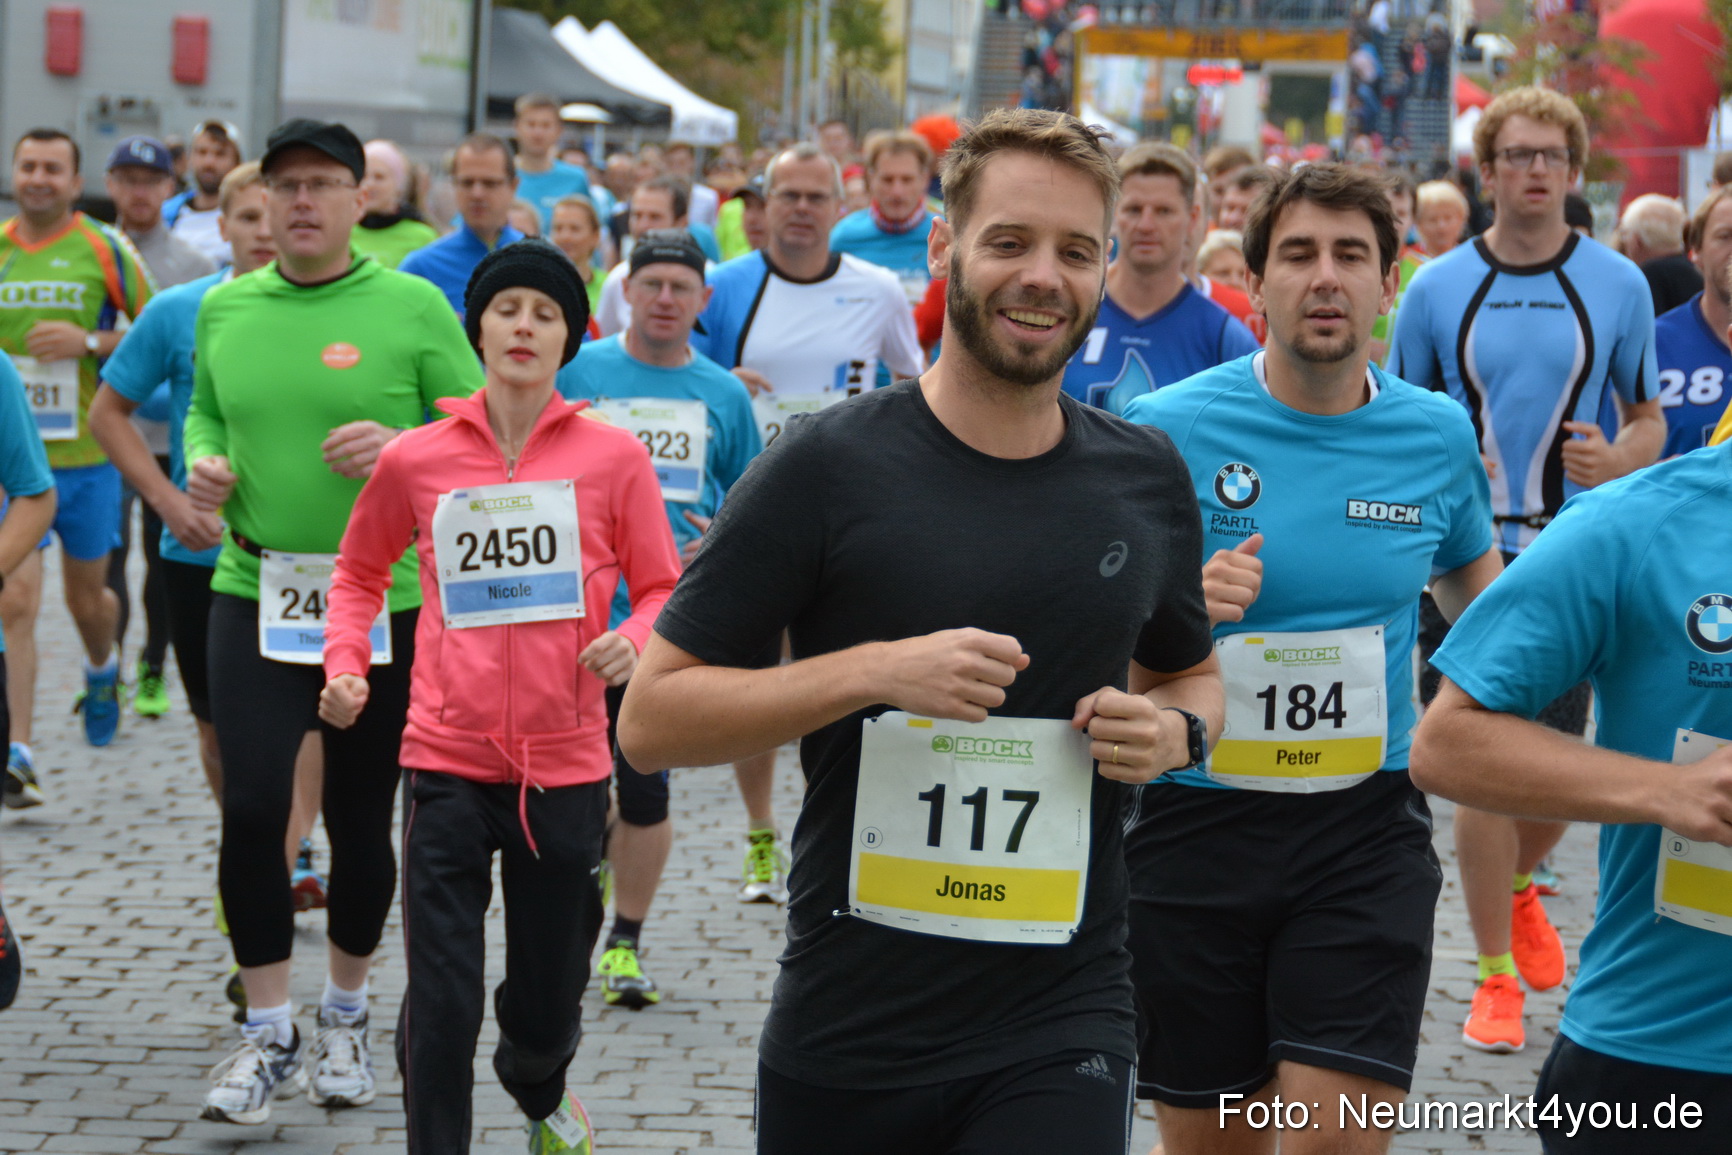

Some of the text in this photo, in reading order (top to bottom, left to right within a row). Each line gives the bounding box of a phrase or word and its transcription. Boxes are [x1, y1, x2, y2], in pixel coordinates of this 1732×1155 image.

[24, 384, 60, 407] 81
[1658, 366, 1724, 408] 28
[1219, 464, 1258, 481] BMW
[482, 495, 534, 511] BOCK
[1346, 499, 1422, 526] BOCK
[1211, 513, 1259, 530] PARTL
[1345, 520, 1422, 534] inspired by smart concepts
[1210, 525, 1258, 538] Neumark
[456, 524, 557, 573] 2450
[488, 583, 532, 600] Nicole
[280, 587, 328, 620] 24
[1692, 595, 1732, 615] BM
[1282, 646, 1340, 662] BOCK
[1256, 681, 1347, 731] 184
[955, 736, 1033, 759] BOCK
[954, 755, 979, 763] inspired
[1276, 749, 1322, 765] Peter
[918, 783, 1040, 853] 117
[867, 832, 876, 844] D
[1674, 841, 1682, 852] D
[935, 875, 1006, 902] Jonas
